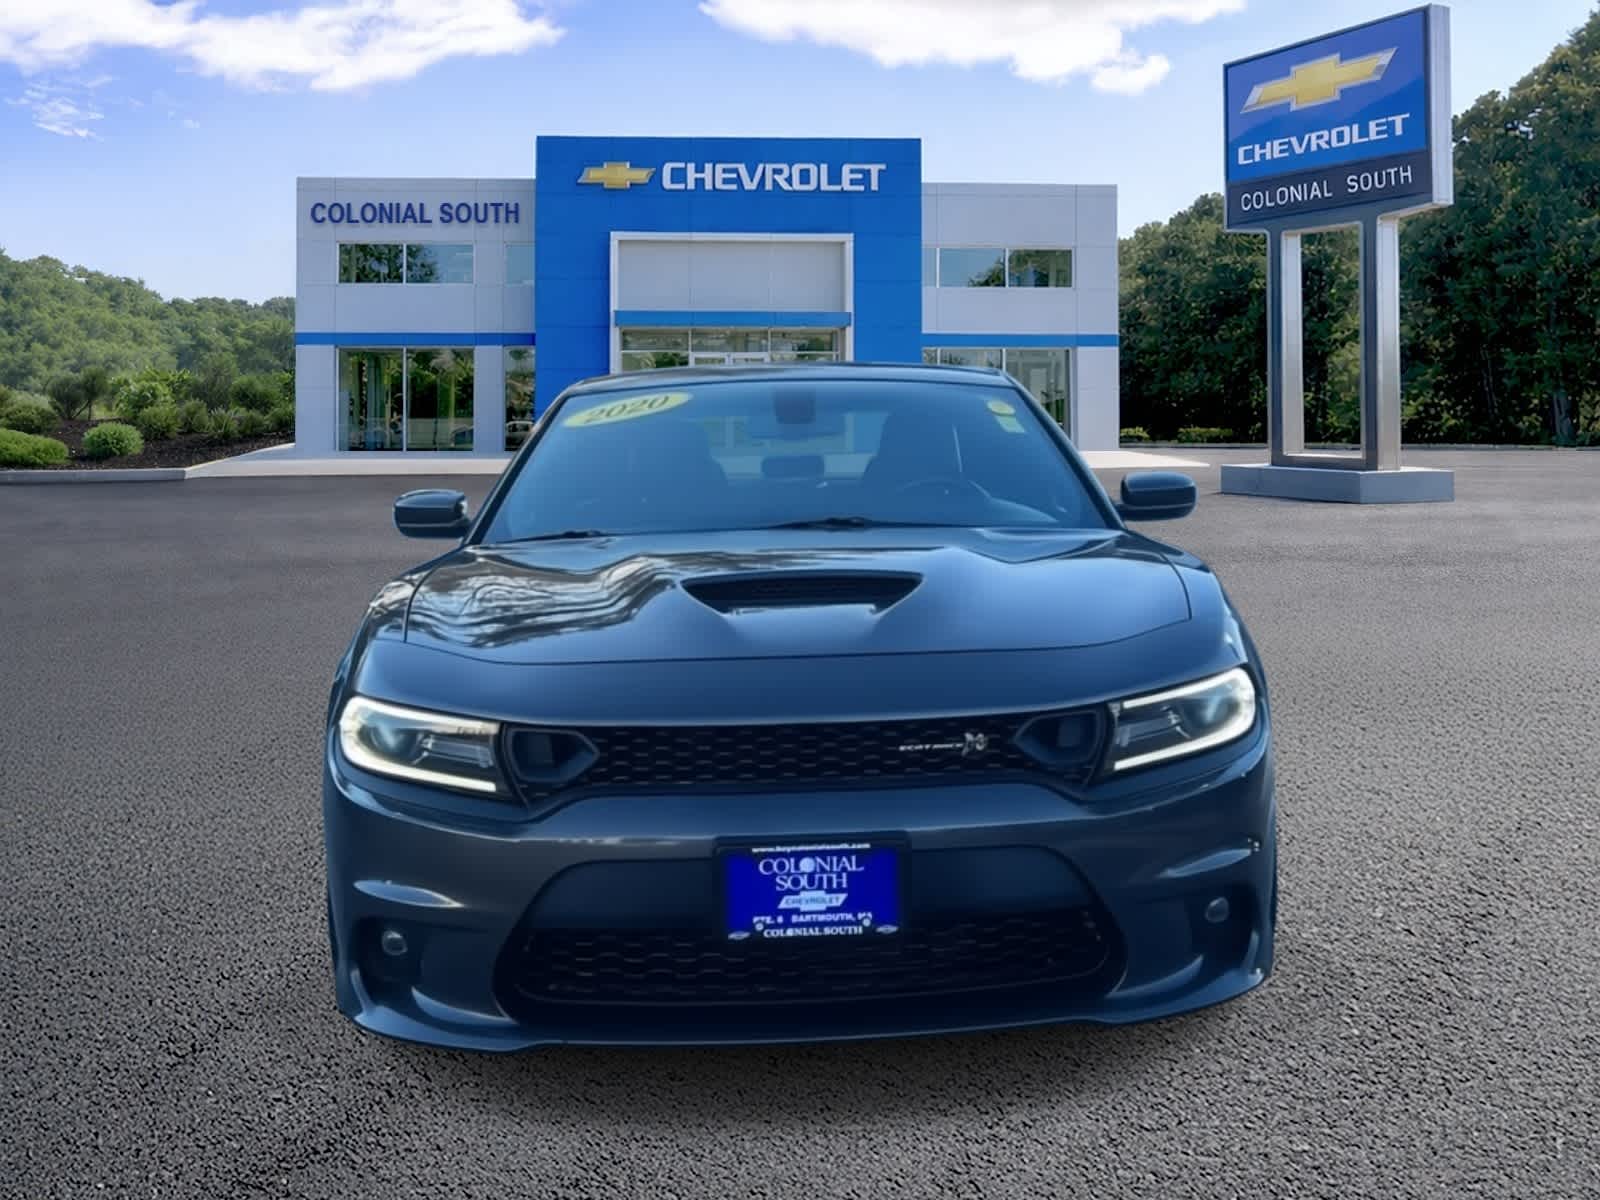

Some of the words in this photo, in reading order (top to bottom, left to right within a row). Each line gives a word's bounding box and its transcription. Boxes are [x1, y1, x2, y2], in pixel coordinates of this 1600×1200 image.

[1237, 113, 1410, 165] CHEVROLET
[662, 162, 887, 191] CHEVROLET
[1241, 179, 1333, 211] COLONIAL
[1346, 165, 1412, 193] SOUTH
[310, 202, 433, 224] COLONIAL
[439, 202, 520, 224] SOUTH
[585, 395, 670, 423] 2020
[758, 855, 865, 875] COLONIAL
[775, 872, 848, 891] SOUTH
[763, 927, 823, 938] COLONIAL
[823, 925, 863, 936] SOUTH
